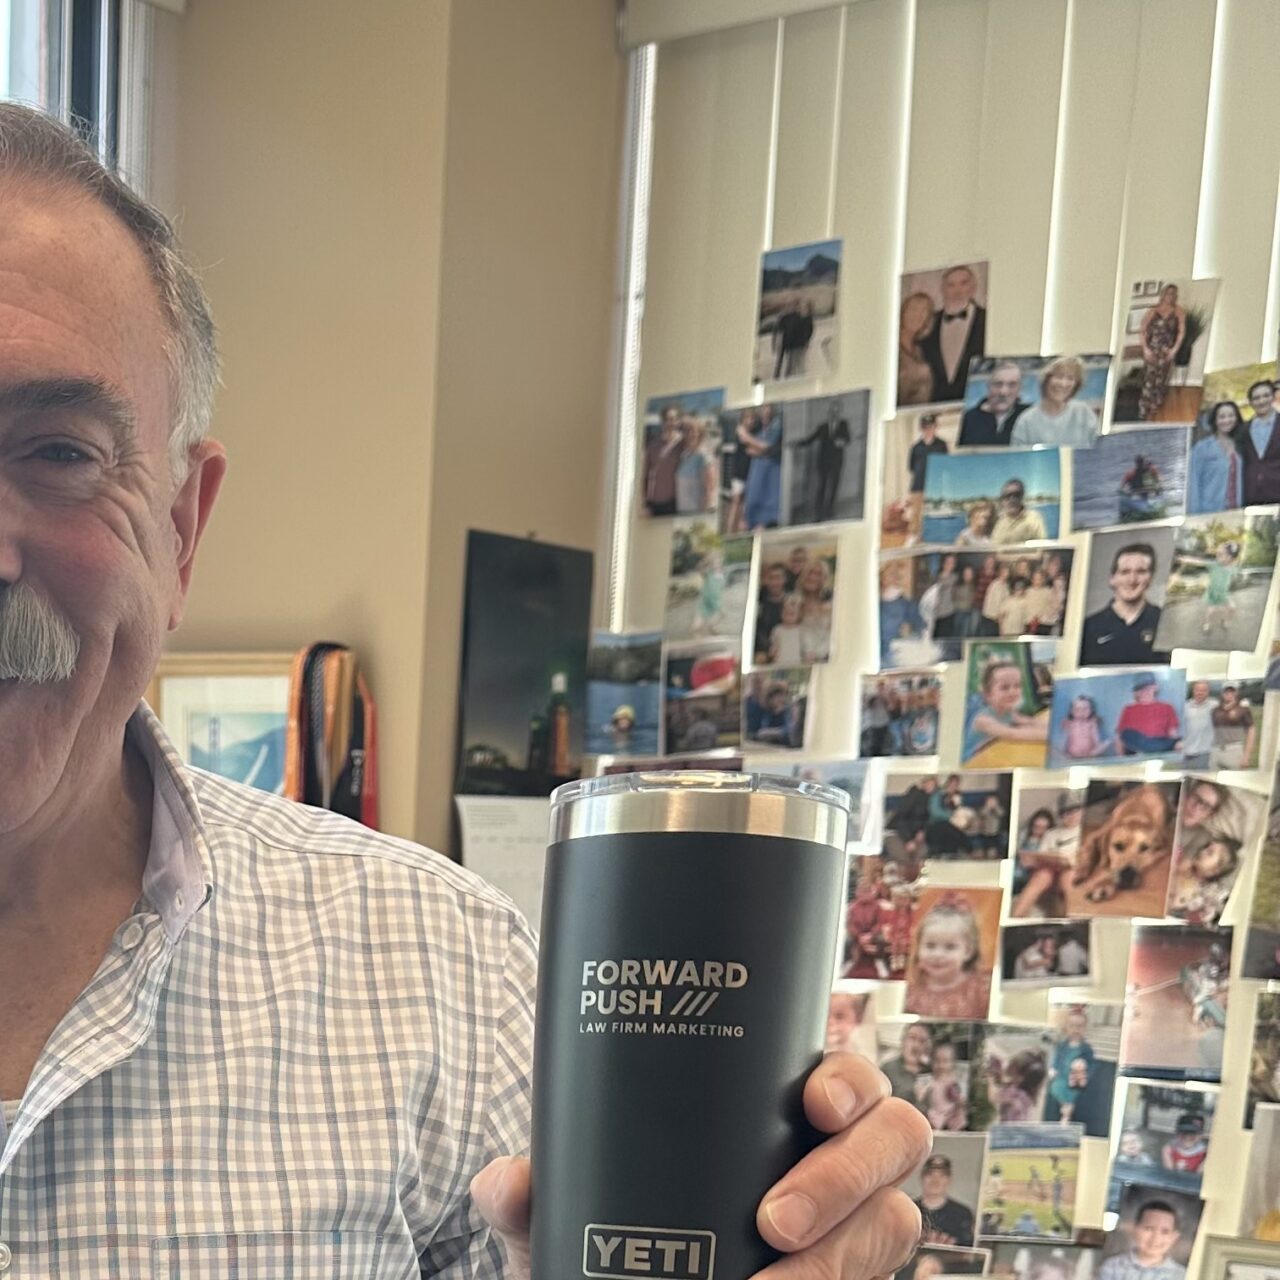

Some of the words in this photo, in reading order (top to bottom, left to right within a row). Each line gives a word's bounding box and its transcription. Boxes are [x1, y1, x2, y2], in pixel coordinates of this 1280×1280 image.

[581, 959, 749, 989] FORWARD
[580, 989, 663, 1016] PUSH
[579, 1022, 607, 1034] LAW
[611, 1022, 648, 1034] FIRM
[652, 1022, 745, 1038] MARKETING
[591, 1233, 701, 1276] YETI
